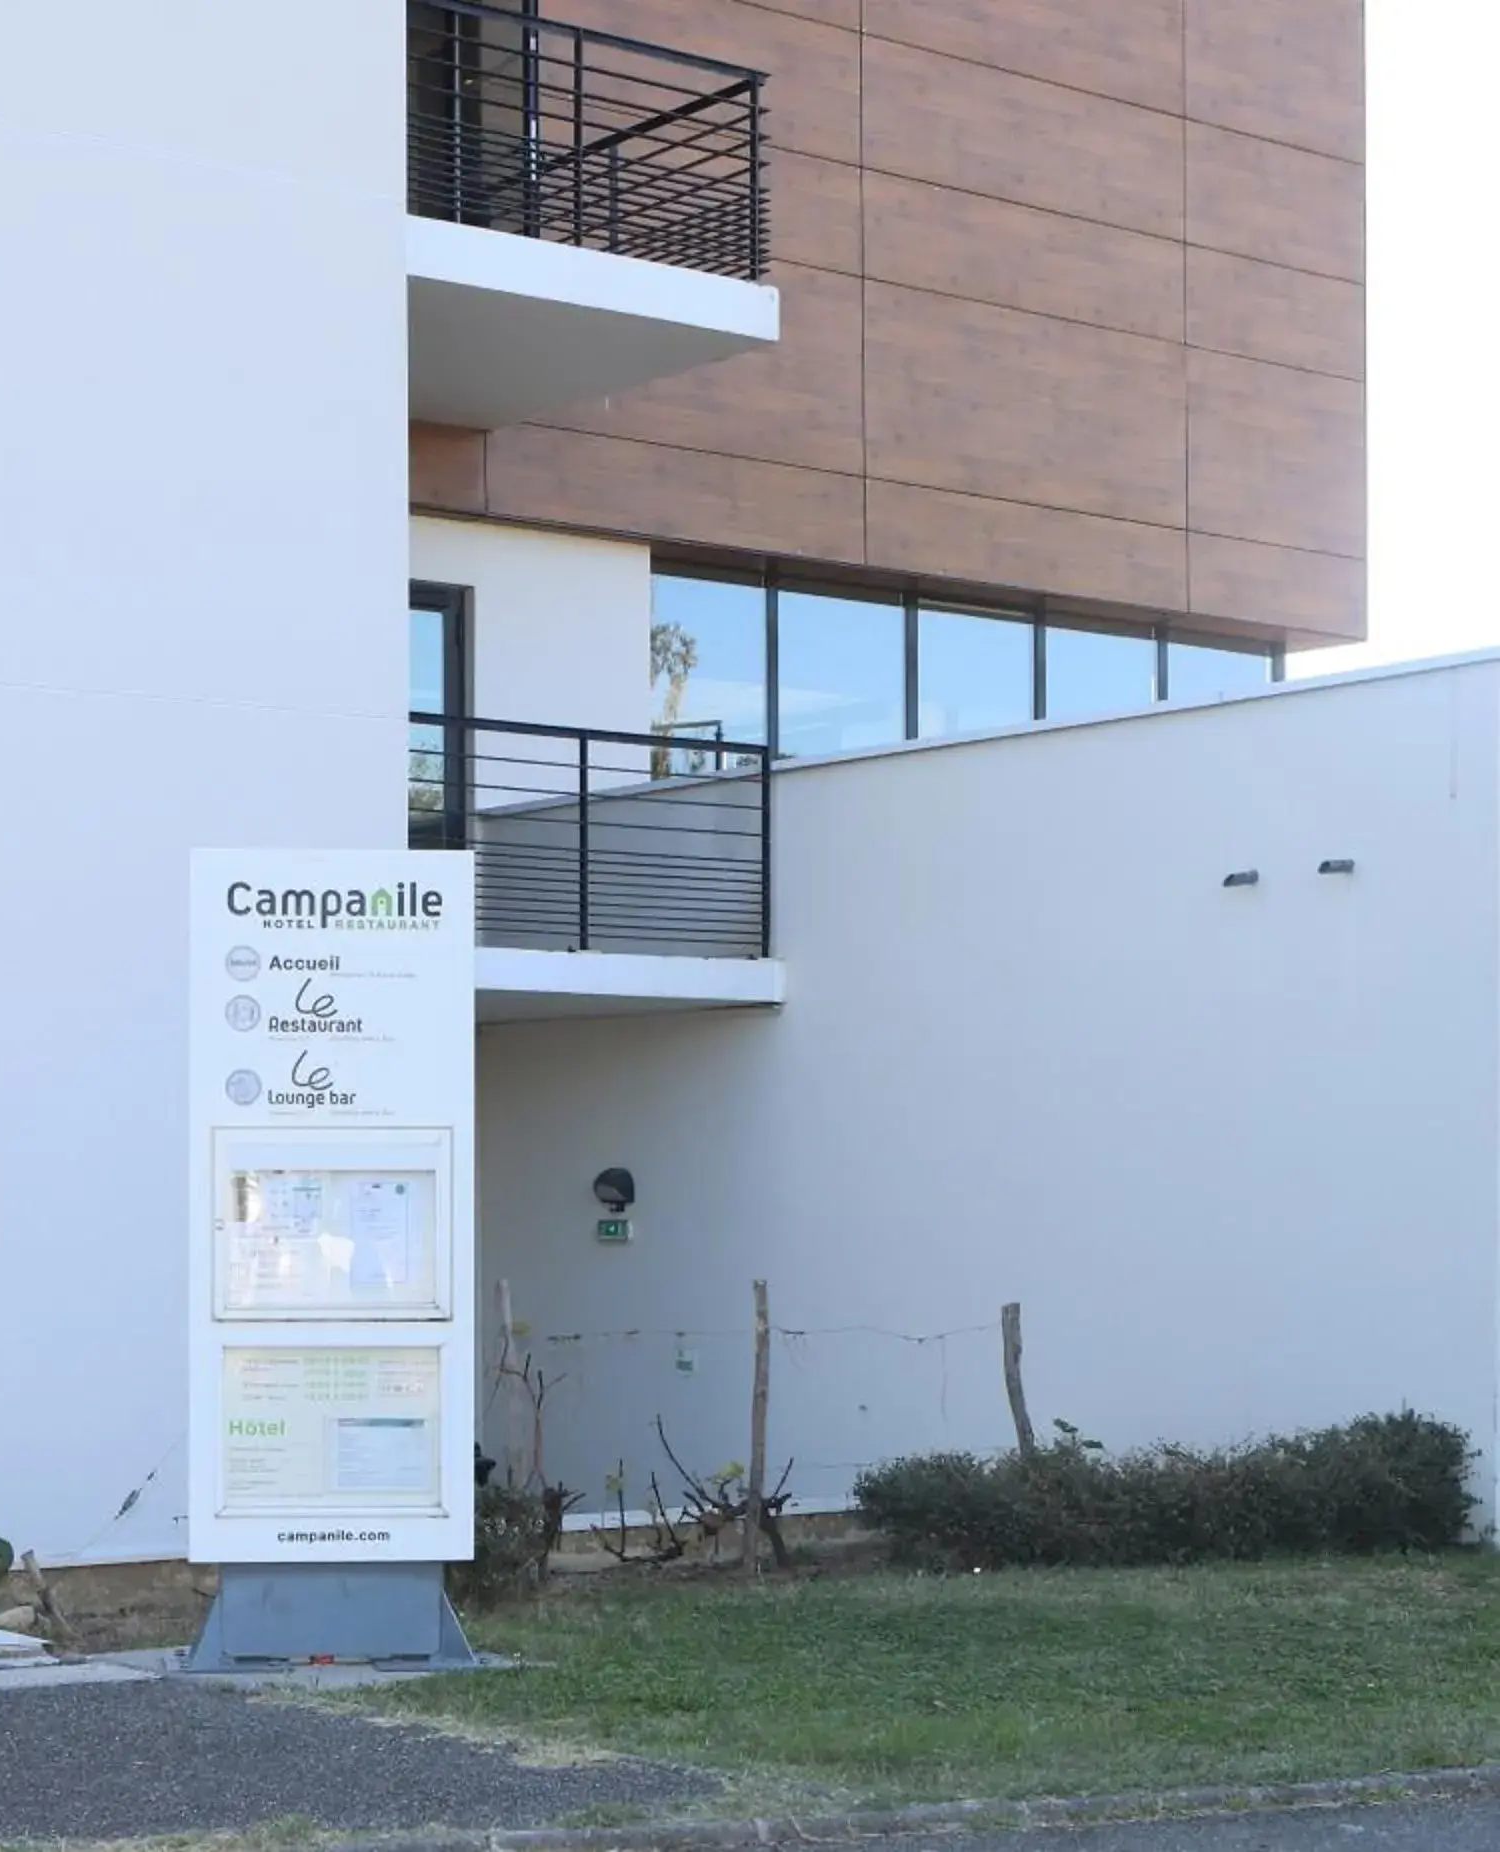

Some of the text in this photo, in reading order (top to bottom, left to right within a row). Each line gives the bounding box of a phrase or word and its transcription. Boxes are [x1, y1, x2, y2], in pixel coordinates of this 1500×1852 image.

[227, 881, 443, 929] Campanile
[263, 919, 441, 931] HOTEL RESTAURANT
[268, 955, 341, 972] Accueil
[295, 977, 338, 1018] Le
[268, 1015, 364, 1034] Restaurant
[291, 1049, 334, 1091] Le
[267, 1089, 357, 1109] Lounge bar
[277, 1528, 391, 1545] campanile.com
